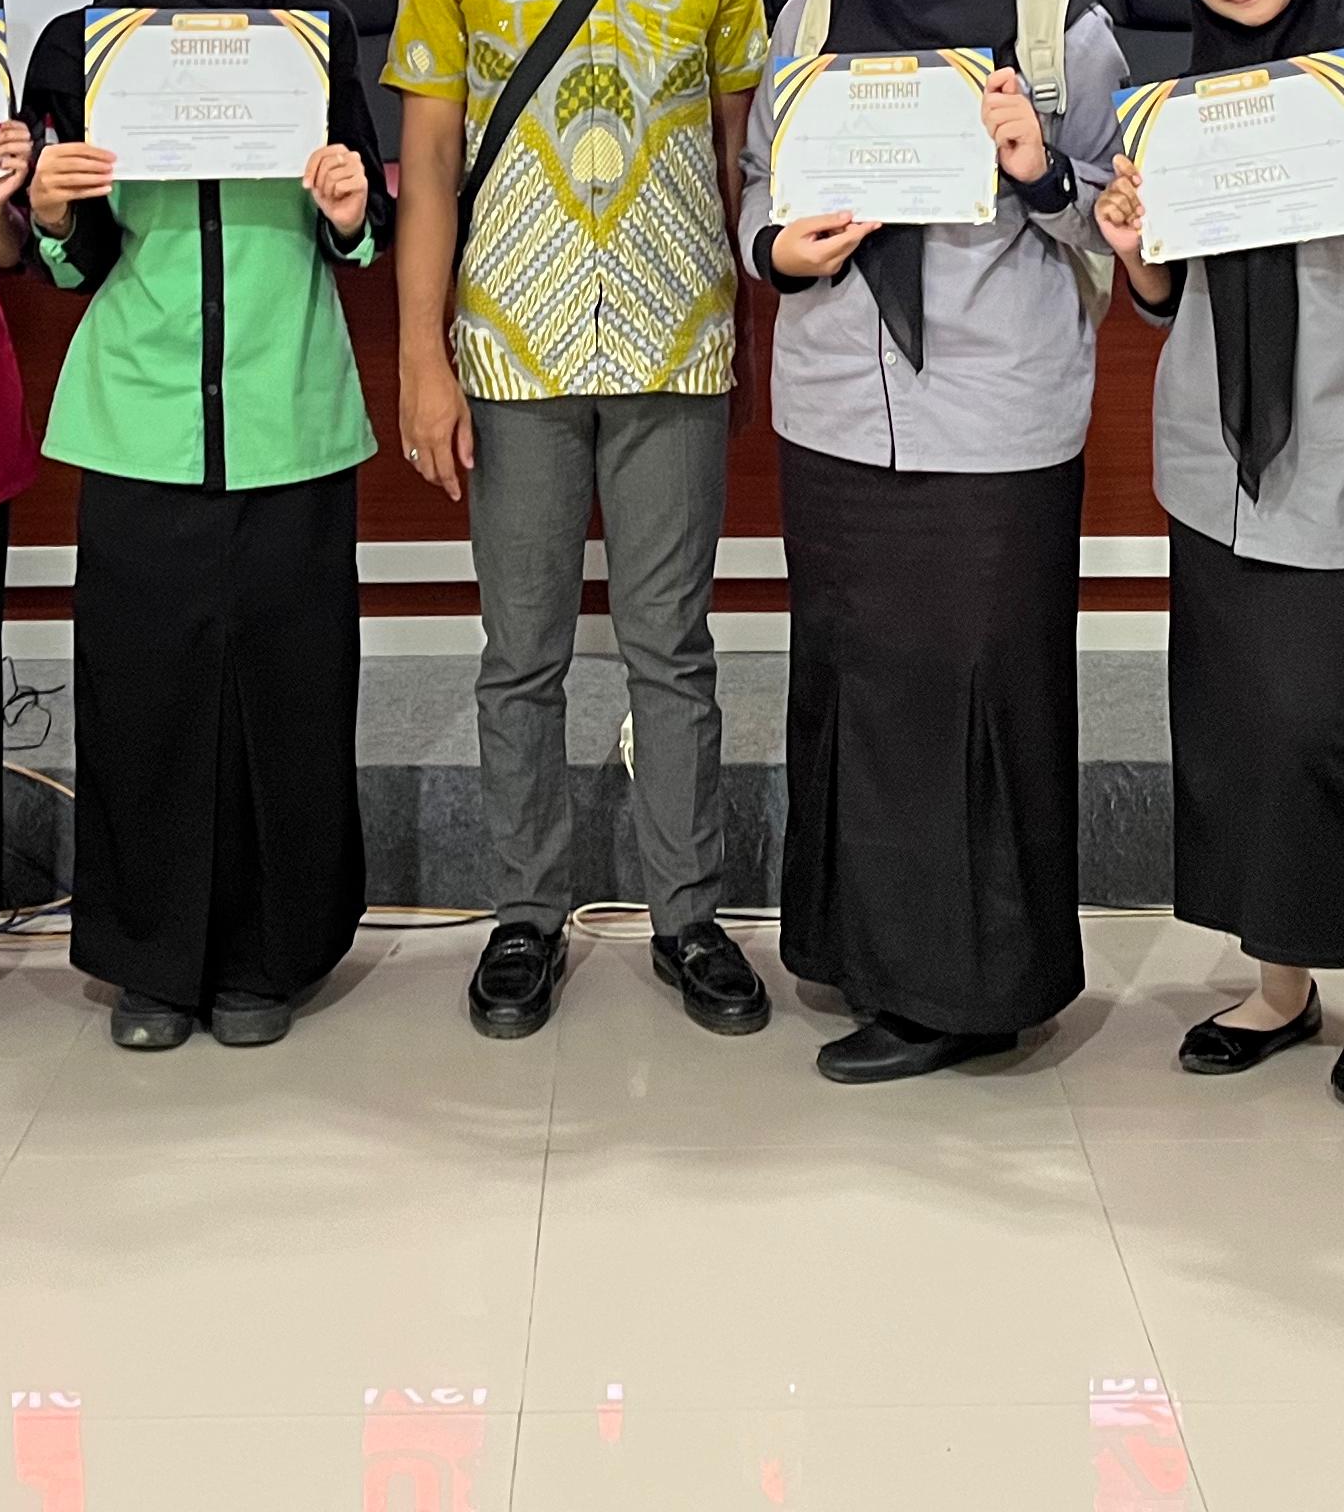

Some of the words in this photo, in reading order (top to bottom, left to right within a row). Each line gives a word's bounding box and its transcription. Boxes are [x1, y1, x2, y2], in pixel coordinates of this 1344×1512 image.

[170, 38, 251, 55] SERTIFIKAT
[849, 81, 922, 99] SERTIFIKAT
[174, 104, 254, 120] PESERTA
[1198, 94, 1276, 122] SERTIFIKAT
[848, 147, 922, 165] PESERTA
[1213, 164, 1292, 191] PESERTA
